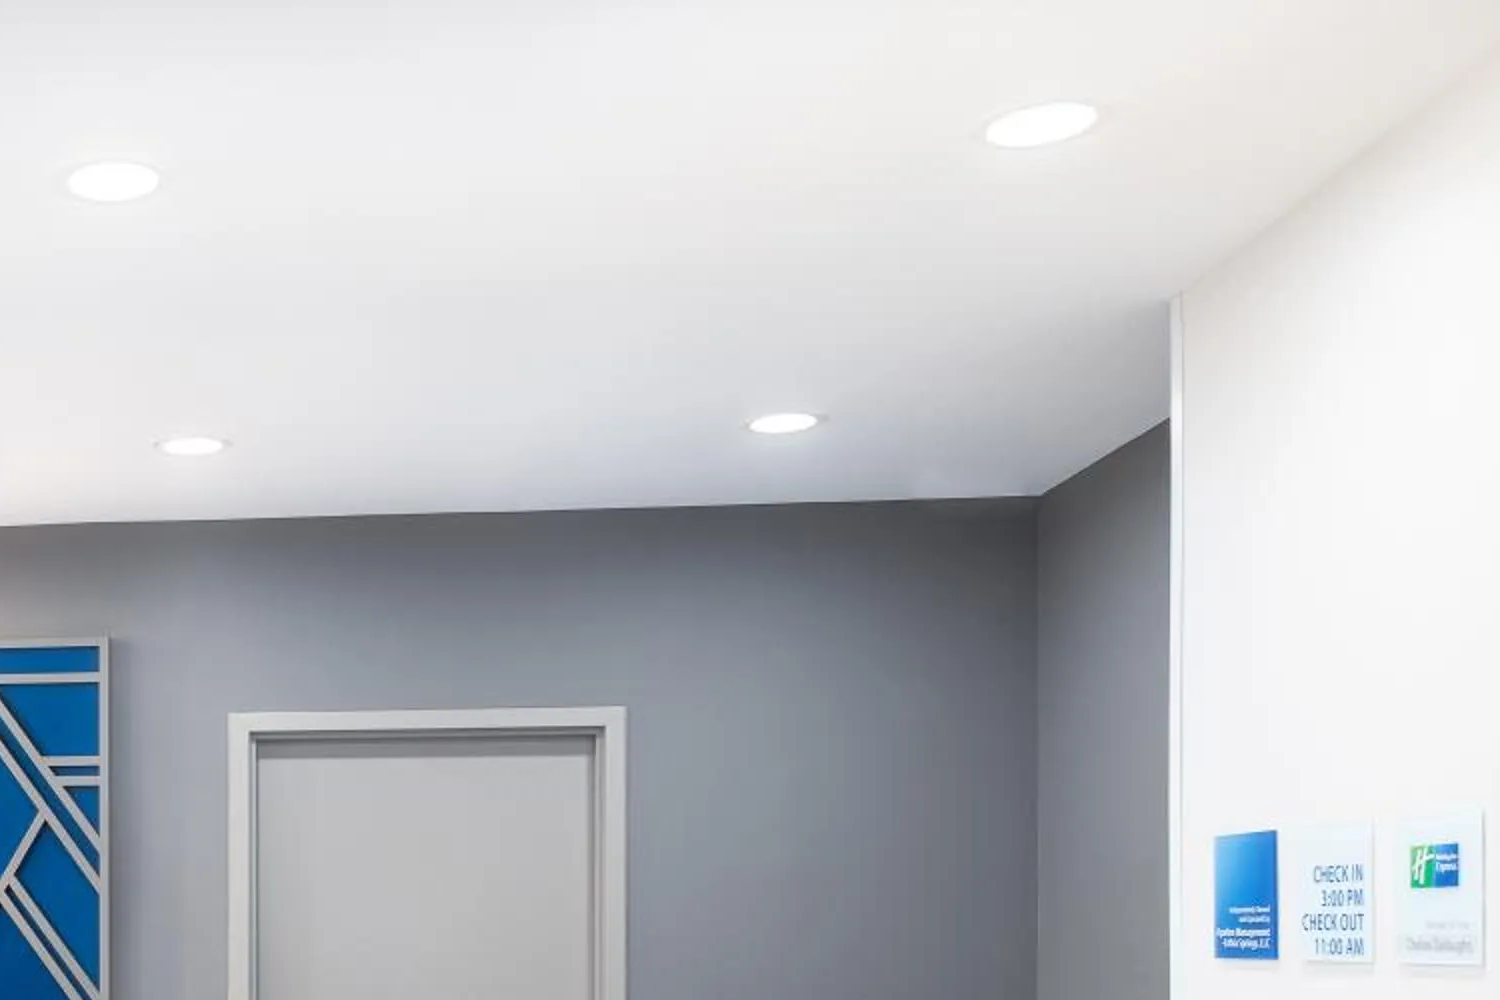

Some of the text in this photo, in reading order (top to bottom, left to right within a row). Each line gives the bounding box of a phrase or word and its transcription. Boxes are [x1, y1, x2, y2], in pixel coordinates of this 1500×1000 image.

[1313, 864, 1363, 883] CHECK IN
[1321, 888, 1365, 907] 3:00 PM
[1301, 913, 1364, 931] CHECK OUT
[1315, 937, 1365, 955] 11:00 AM
